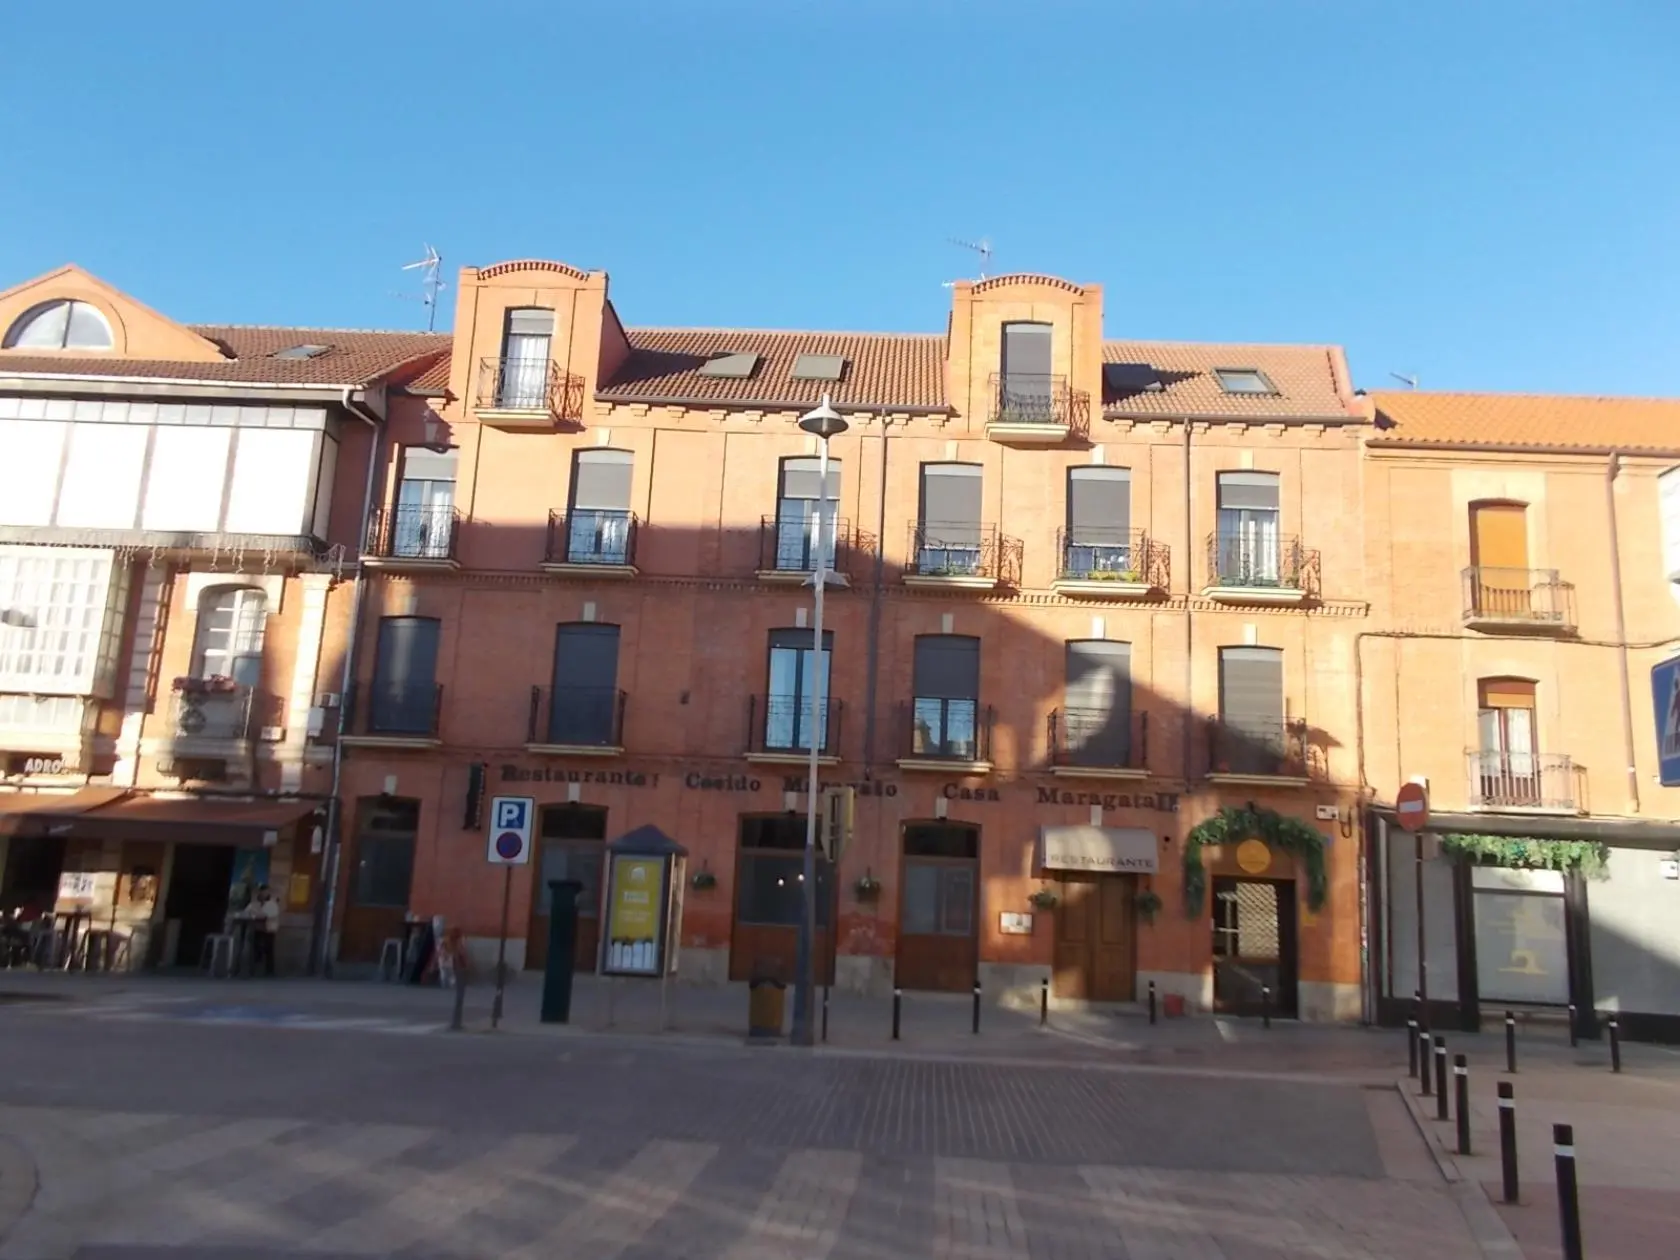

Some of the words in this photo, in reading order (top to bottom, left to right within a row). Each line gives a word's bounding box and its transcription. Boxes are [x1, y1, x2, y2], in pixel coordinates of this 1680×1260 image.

[501, 764, 646, 786] Restaurante
[783, 777, 898, 797] Mrato
[943, 783, 1000, 800] Casa
[1037, 786, 1154, 812] Maragata
[500, 803, 520, 827] P
[1050, 854, 1154, 868] RESTAURANTE
